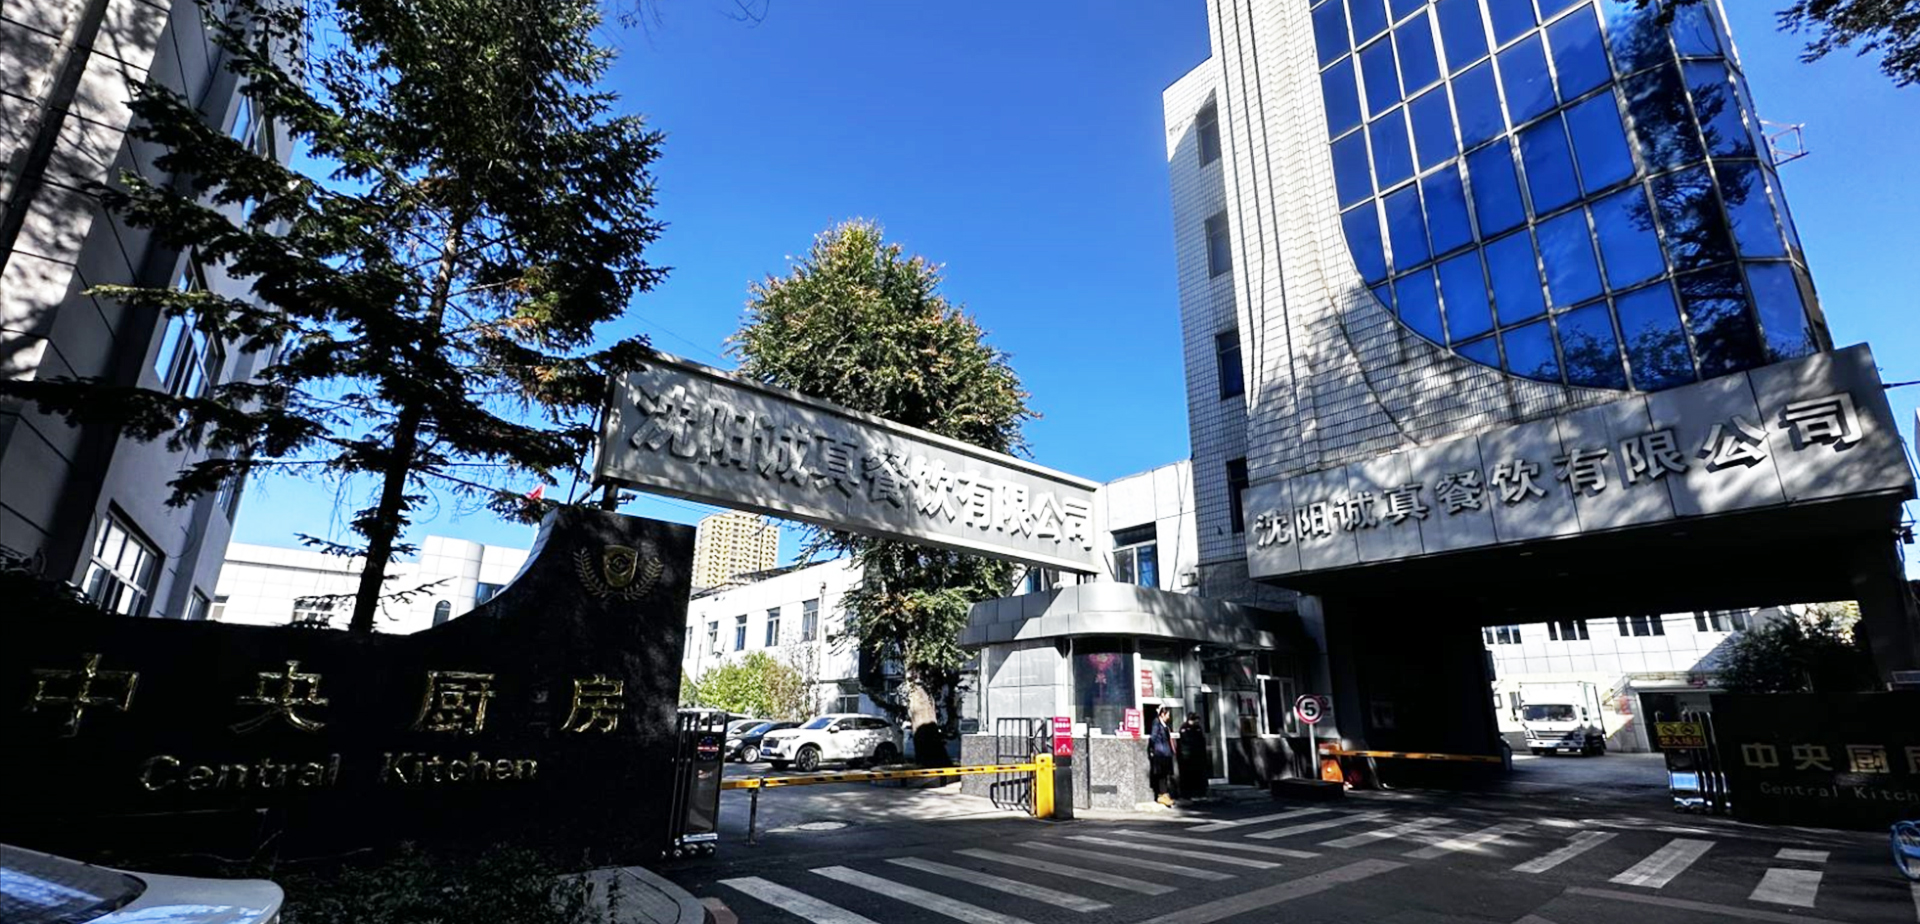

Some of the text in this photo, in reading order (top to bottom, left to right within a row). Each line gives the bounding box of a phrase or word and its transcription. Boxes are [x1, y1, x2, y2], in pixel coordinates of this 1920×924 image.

[631, 385, 1094, 550] 沈阳诚真餐饮有限公司
[1254, 393, 1863, 549] 沈阳诚真餐饮有限公司
[25, 652, 625, 738] 中央厨房
[1304, 702, 1316, 717] 5
[138, 751, 538, 792] Central Kitchen
[1760, 781, 1838, 798] Central
